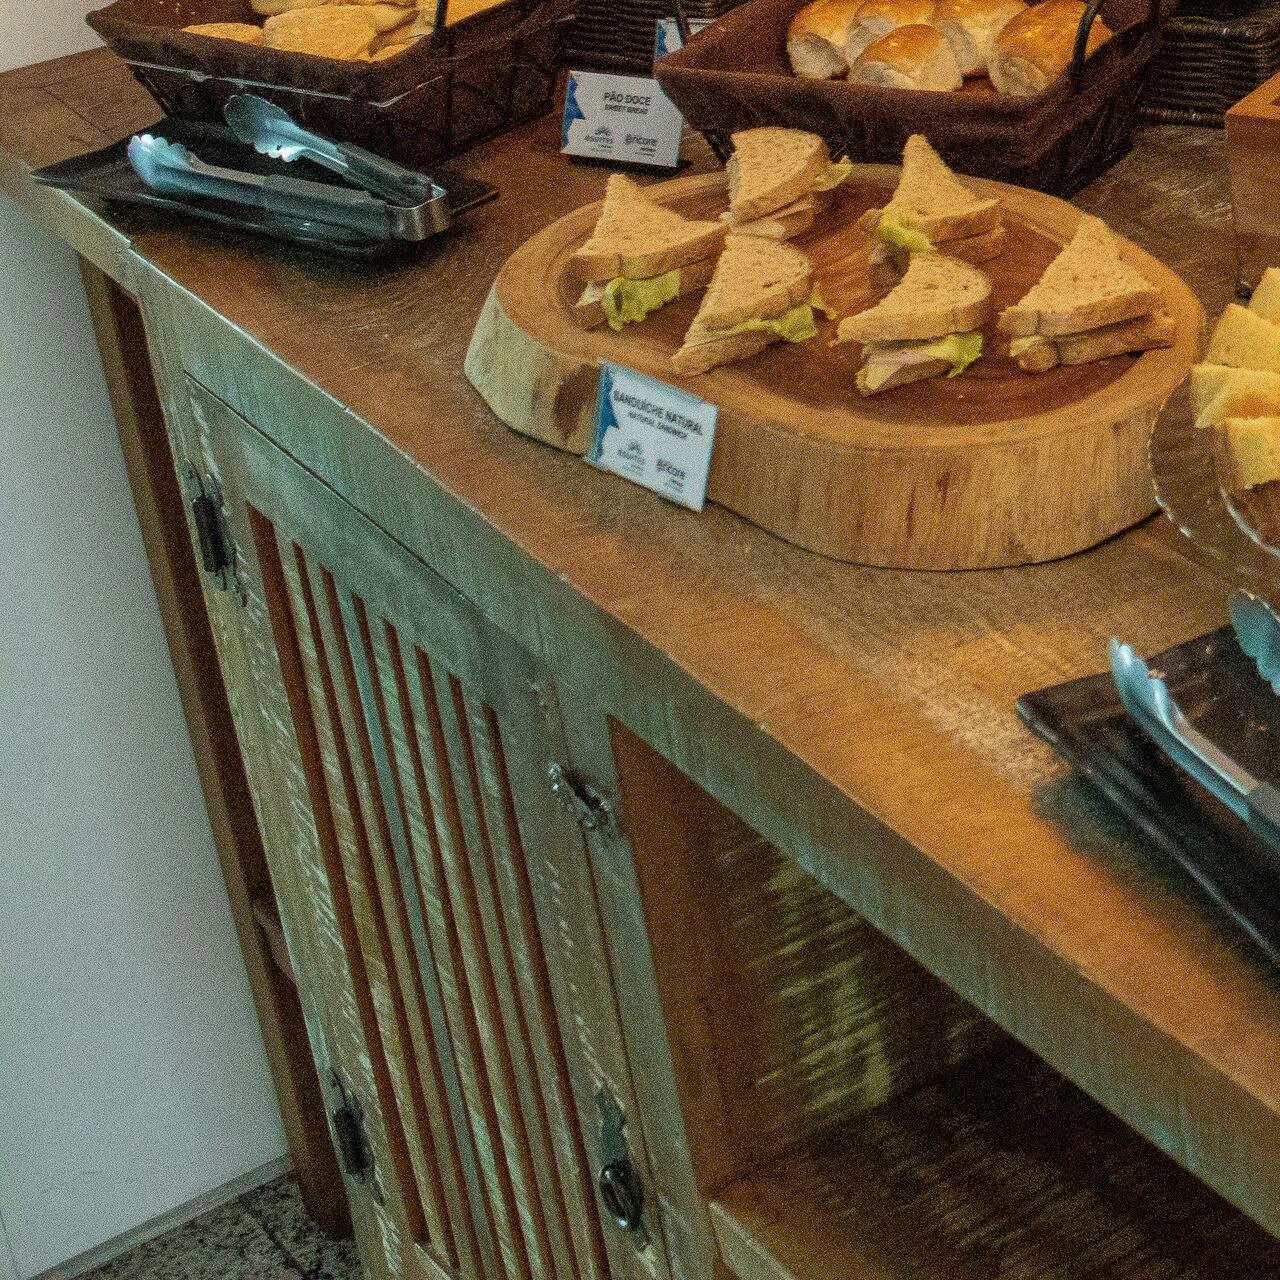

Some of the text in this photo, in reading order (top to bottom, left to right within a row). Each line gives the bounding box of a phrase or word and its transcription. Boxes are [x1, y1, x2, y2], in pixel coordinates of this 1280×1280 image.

[603, 91, 651, 106] PÃO DOCE
[665, 410, 703, 436] NATURAL
